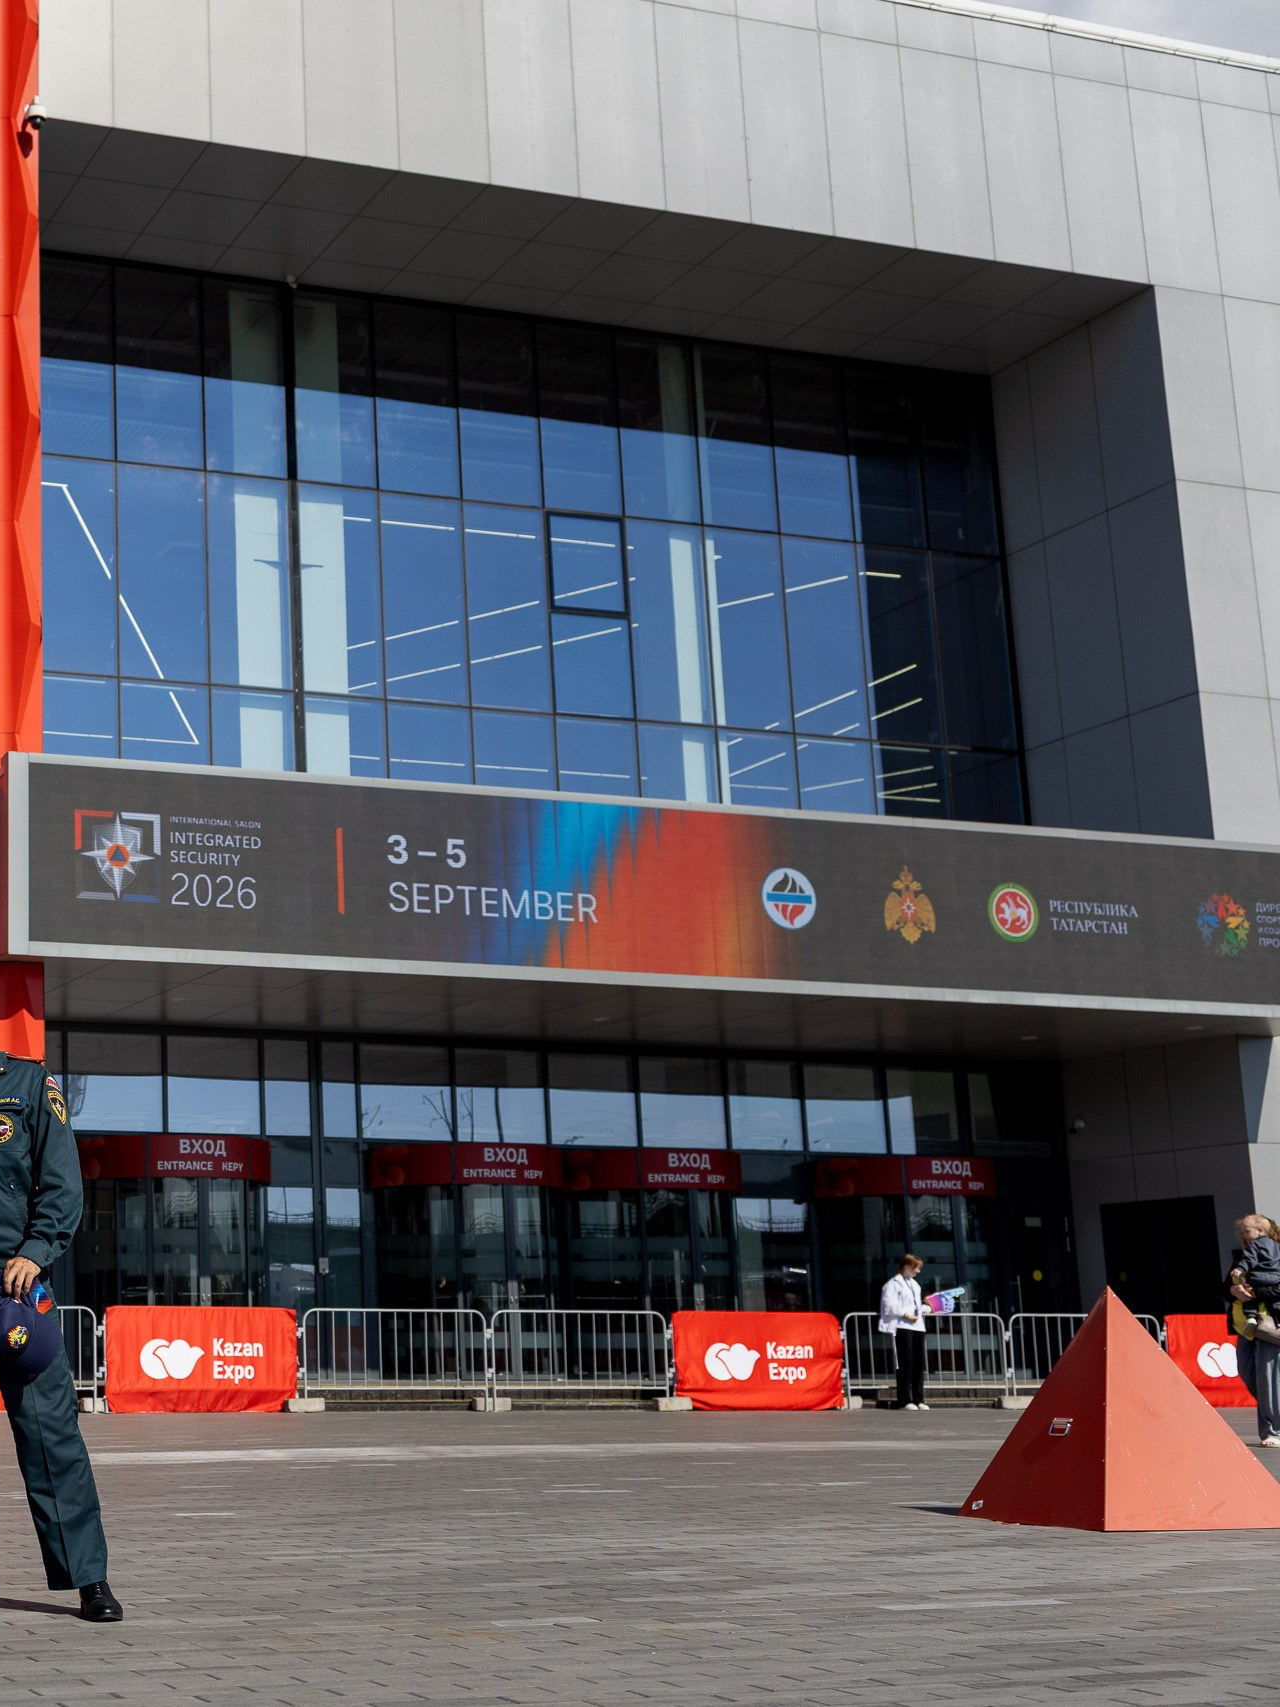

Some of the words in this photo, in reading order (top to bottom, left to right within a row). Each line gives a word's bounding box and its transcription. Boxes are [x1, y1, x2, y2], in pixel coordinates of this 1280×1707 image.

[169, 816, 232, 827] INTERNATIONAL
[235, 820, 261, 829] SALON
[170, 831, 262, 849] INTEGRATED
[170, 850, 240, 866] SECURITY
[387, 834, 409, 865] 3
[446, 838, 467, 868] 5
[171, 872, 257, 910] 2026
[388, 881, 599, 923] SEPTEMBER
[1049, 899, 1139, 918] РЕСПУБЛИКА
[1050, 917, 1129, 935] ТАТАРСТАН
[179, 1139, 227, 1157] ВХОД
[484, 1147, 529, 1165] ВХОД
[157, 1160, 214, 1171] ENTRANCE
[668, 1152, 712, 1170] ВХОД
[931, 1160, 972, 1177] ВХОД
[463, 1168, 517, 1178] ENTRANCE
[648, 1173, 701, 1183] ENTRANCE
[912, 1180, 962, 1190] ENTRANCE
[213, 1338, 264, 1357] Kazan
[766, 1341, 814, 1359] Kazan
[213, 1360, 255, 1384] Expo
[768, 1362, 807, 1385] Expo
